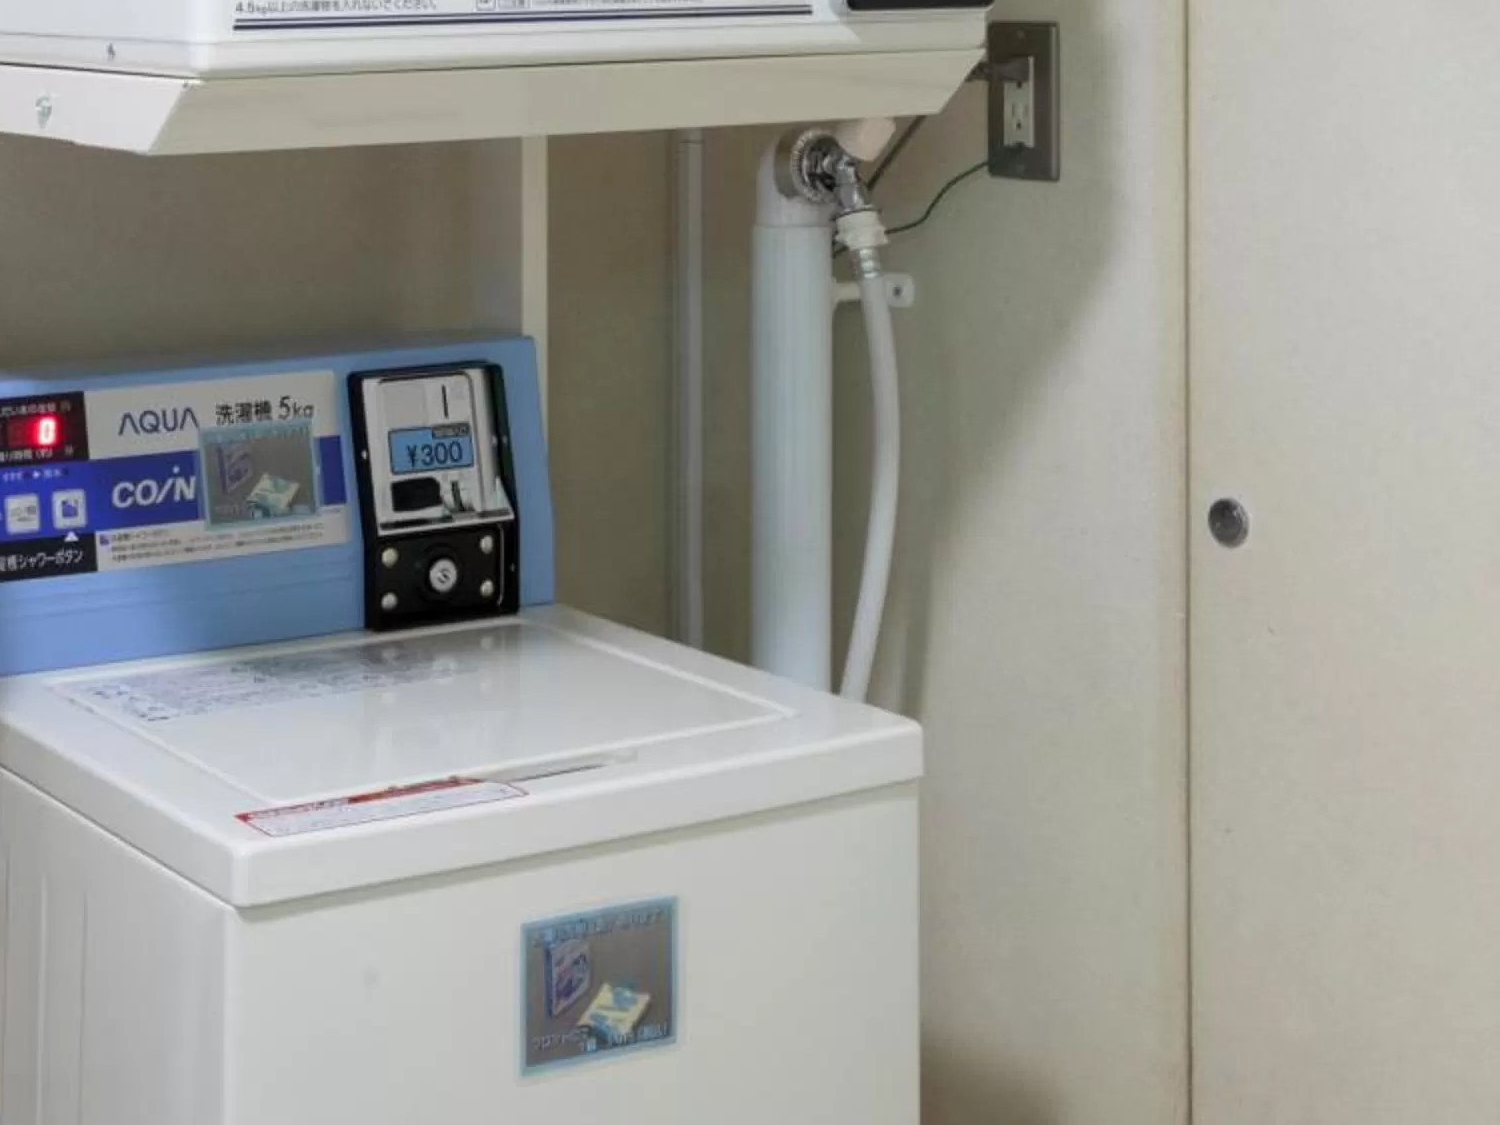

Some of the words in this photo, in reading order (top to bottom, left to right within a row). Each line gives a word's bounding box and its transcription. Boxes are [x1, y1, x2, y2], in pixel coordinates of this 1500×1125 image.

[37, 416, 57, 446] 0
[117, 406, 199, 437] AQUA
[406, 440, 463, 468] ¥300
